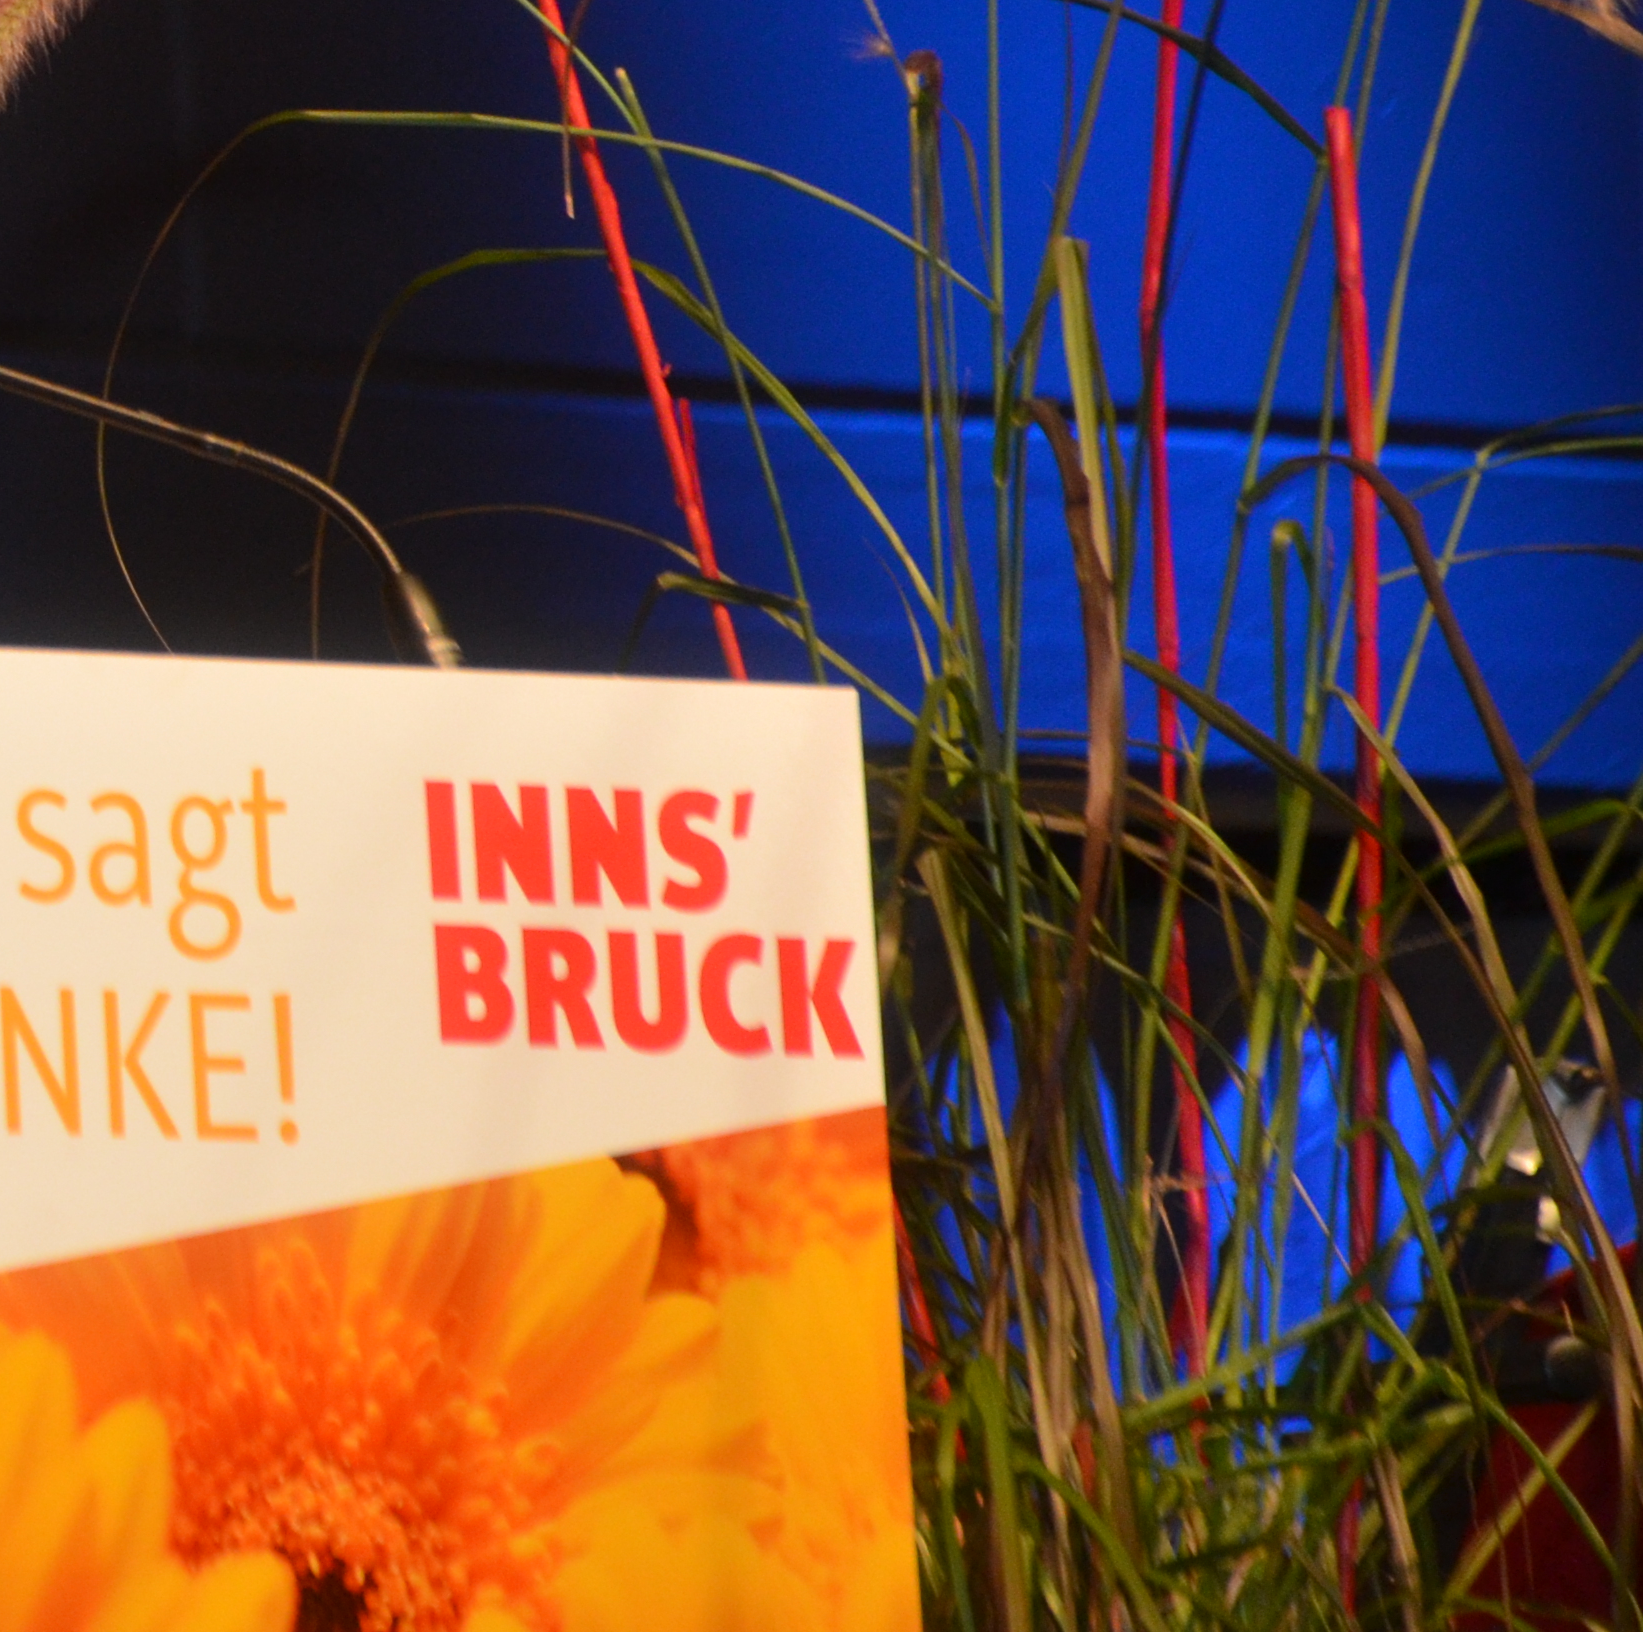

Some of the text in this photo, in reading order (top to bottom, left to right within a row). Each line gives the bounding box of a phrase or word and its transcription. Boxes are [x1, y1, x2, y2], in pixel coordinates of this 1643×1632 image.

[14, 765, 300, 964] sagt
[422, 776, 756, 916] INNS'
[431, 919, 866, 1061] BRUCK
